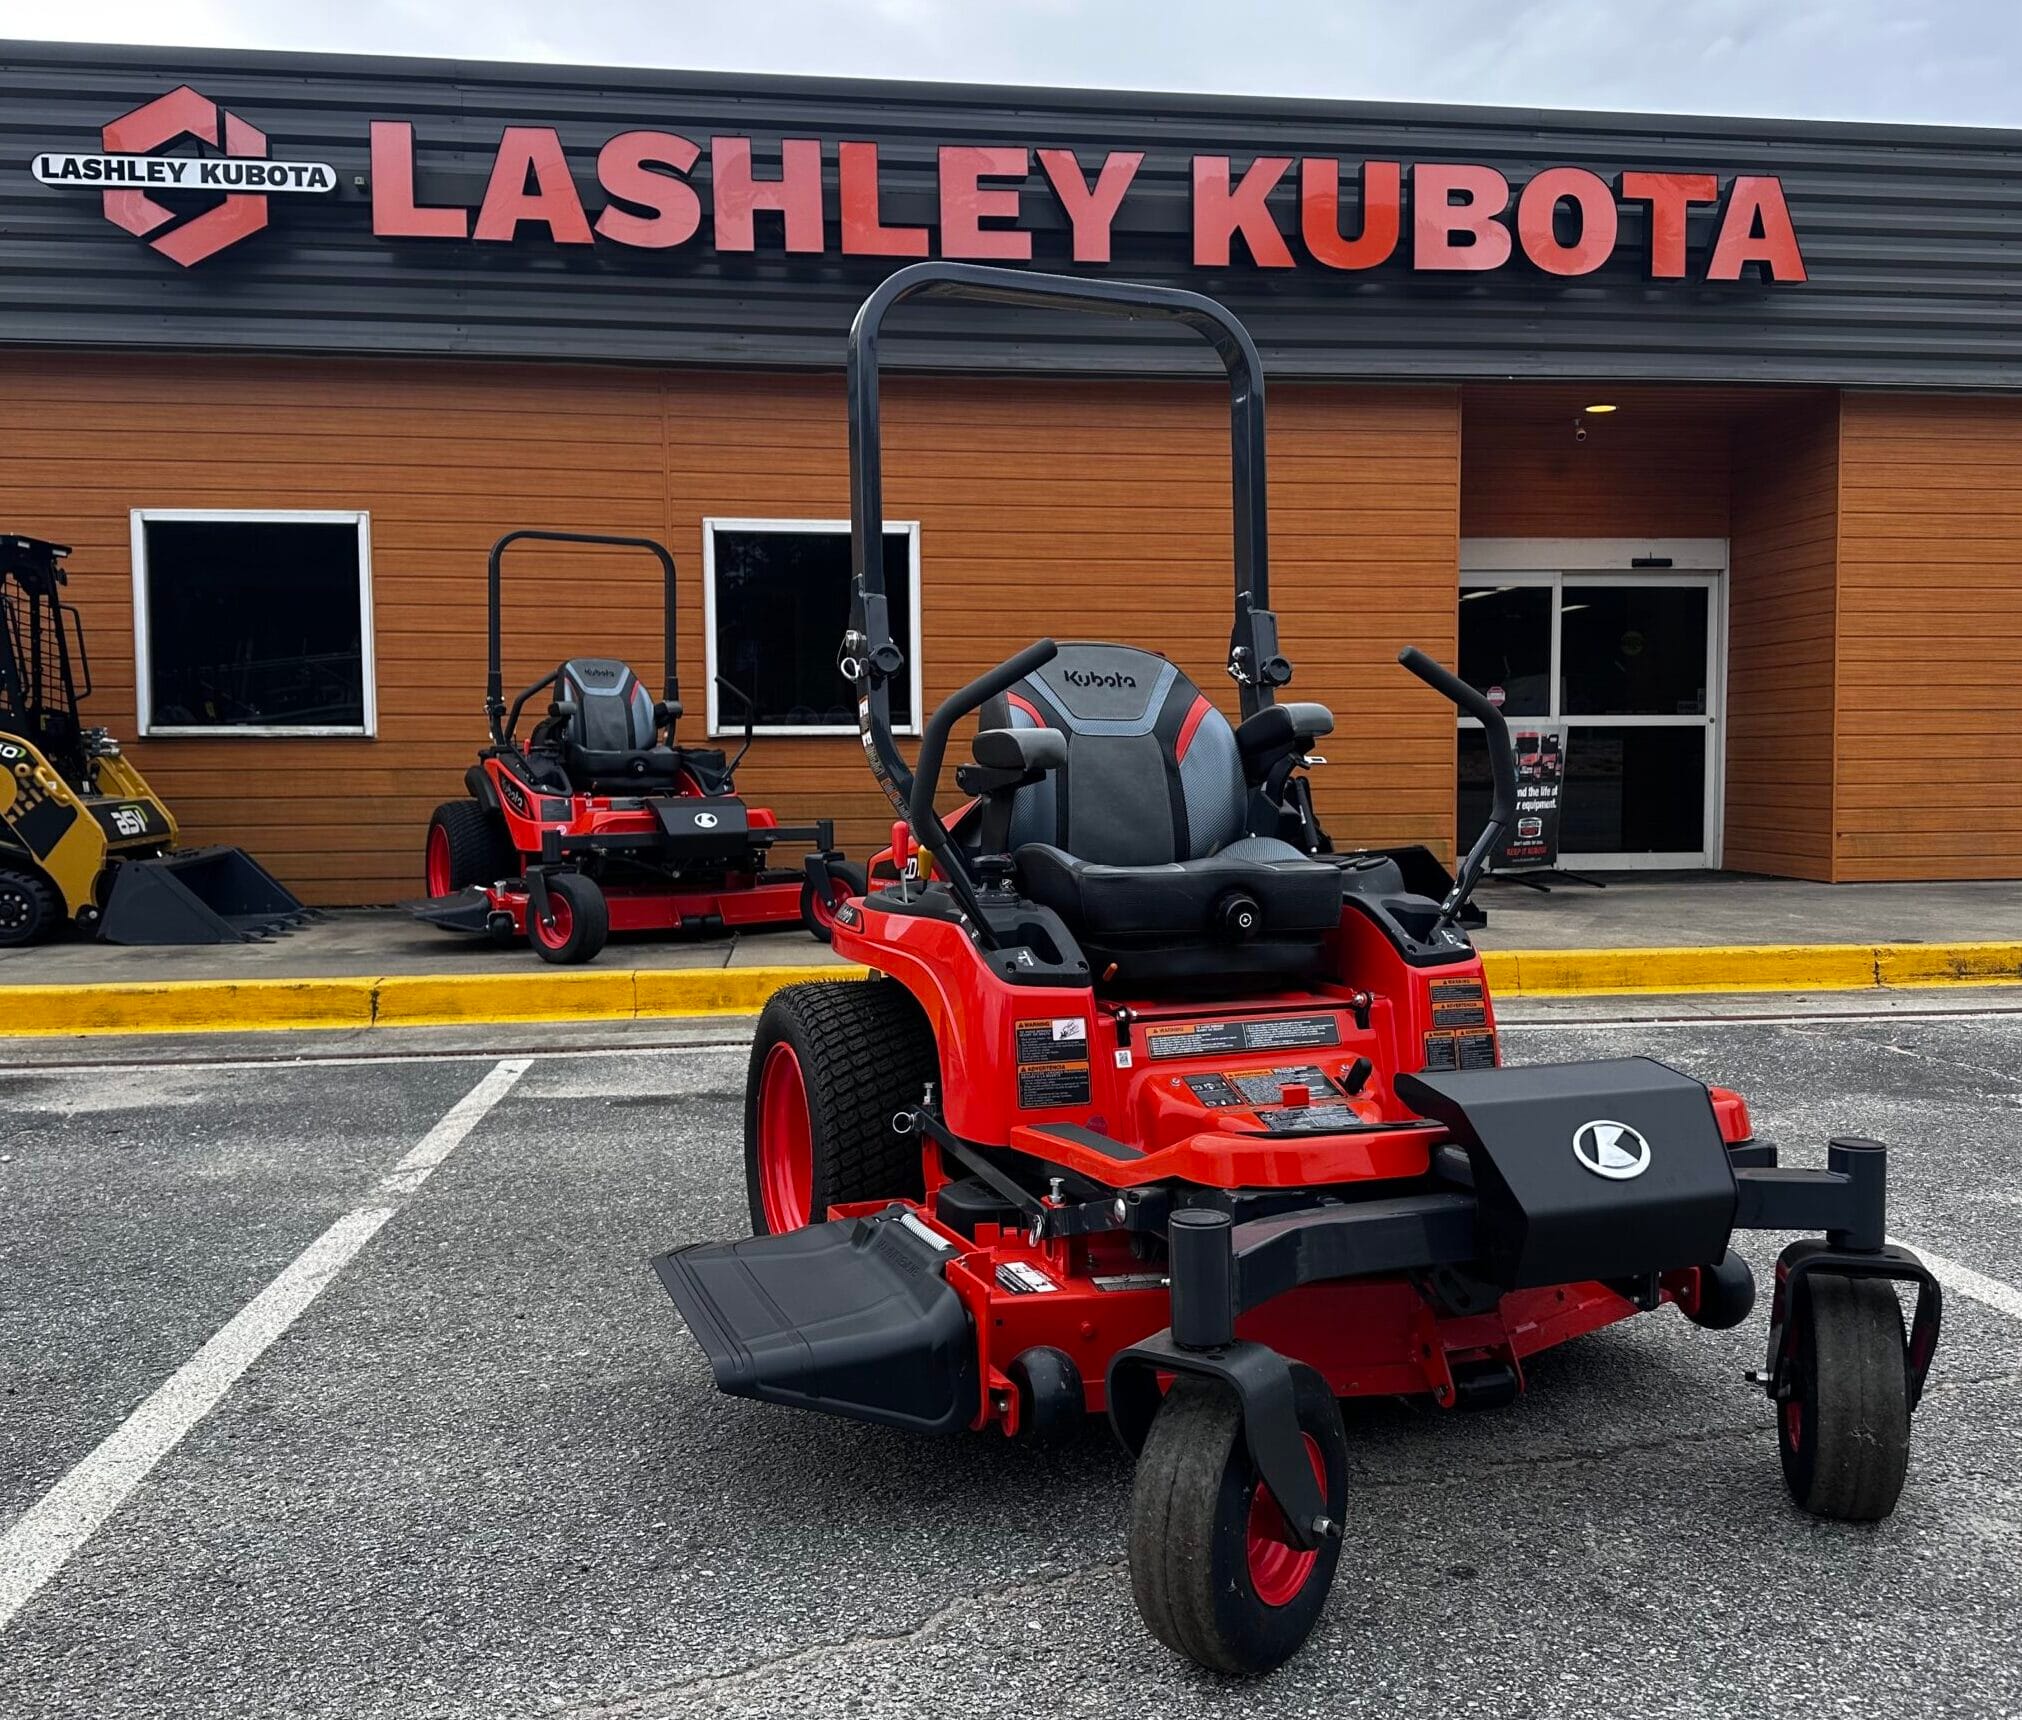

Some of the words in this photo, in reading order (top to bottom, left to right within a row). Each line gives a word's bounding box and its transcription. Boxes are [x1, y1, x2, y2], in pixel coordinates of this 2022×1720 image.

[41, 157, 188, 184] LASHLEY
[201, 162, 329, 188] KUBOTA
[369, 120, 1146, 263] LASHLEY
[1191, 153, 1809, 283] KUBOTA
[584, 667, 615, 678] Kubota
[1063, 669, 1137, 688] Kubota
[0, 743, 18, 759] 0
[1528, 785, 1539, 797] the
[1540, 785, 1551, 796] life
[1551, 784, 1558, 796] of
[1027, 1064, 1066, 1072] ADVERTENCIA
